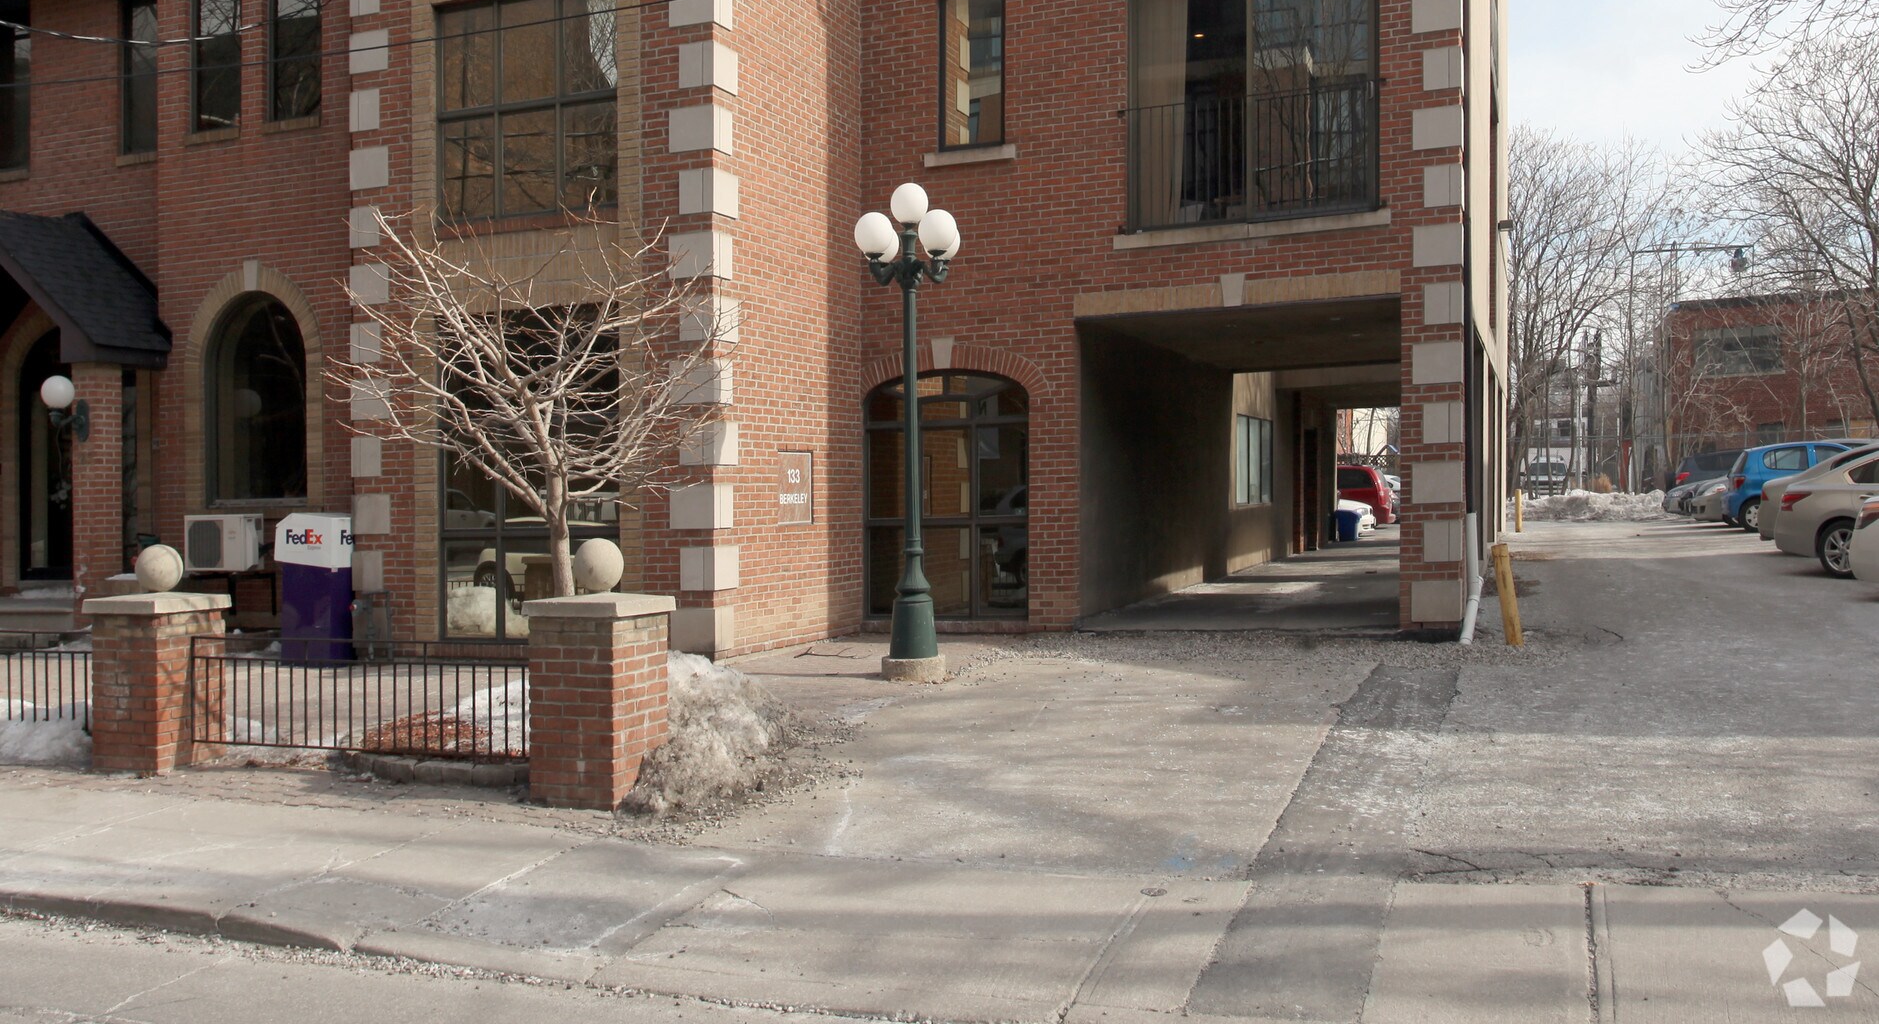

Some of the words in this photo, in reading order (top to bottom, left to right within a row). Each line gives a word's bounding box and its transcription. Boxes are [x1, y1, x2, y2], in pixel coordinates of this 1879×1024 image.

[787, 468, 801, 484] 133
[779, 493, 808, 505] BERKELEY
[286, 528, 323, 545] FedEx
